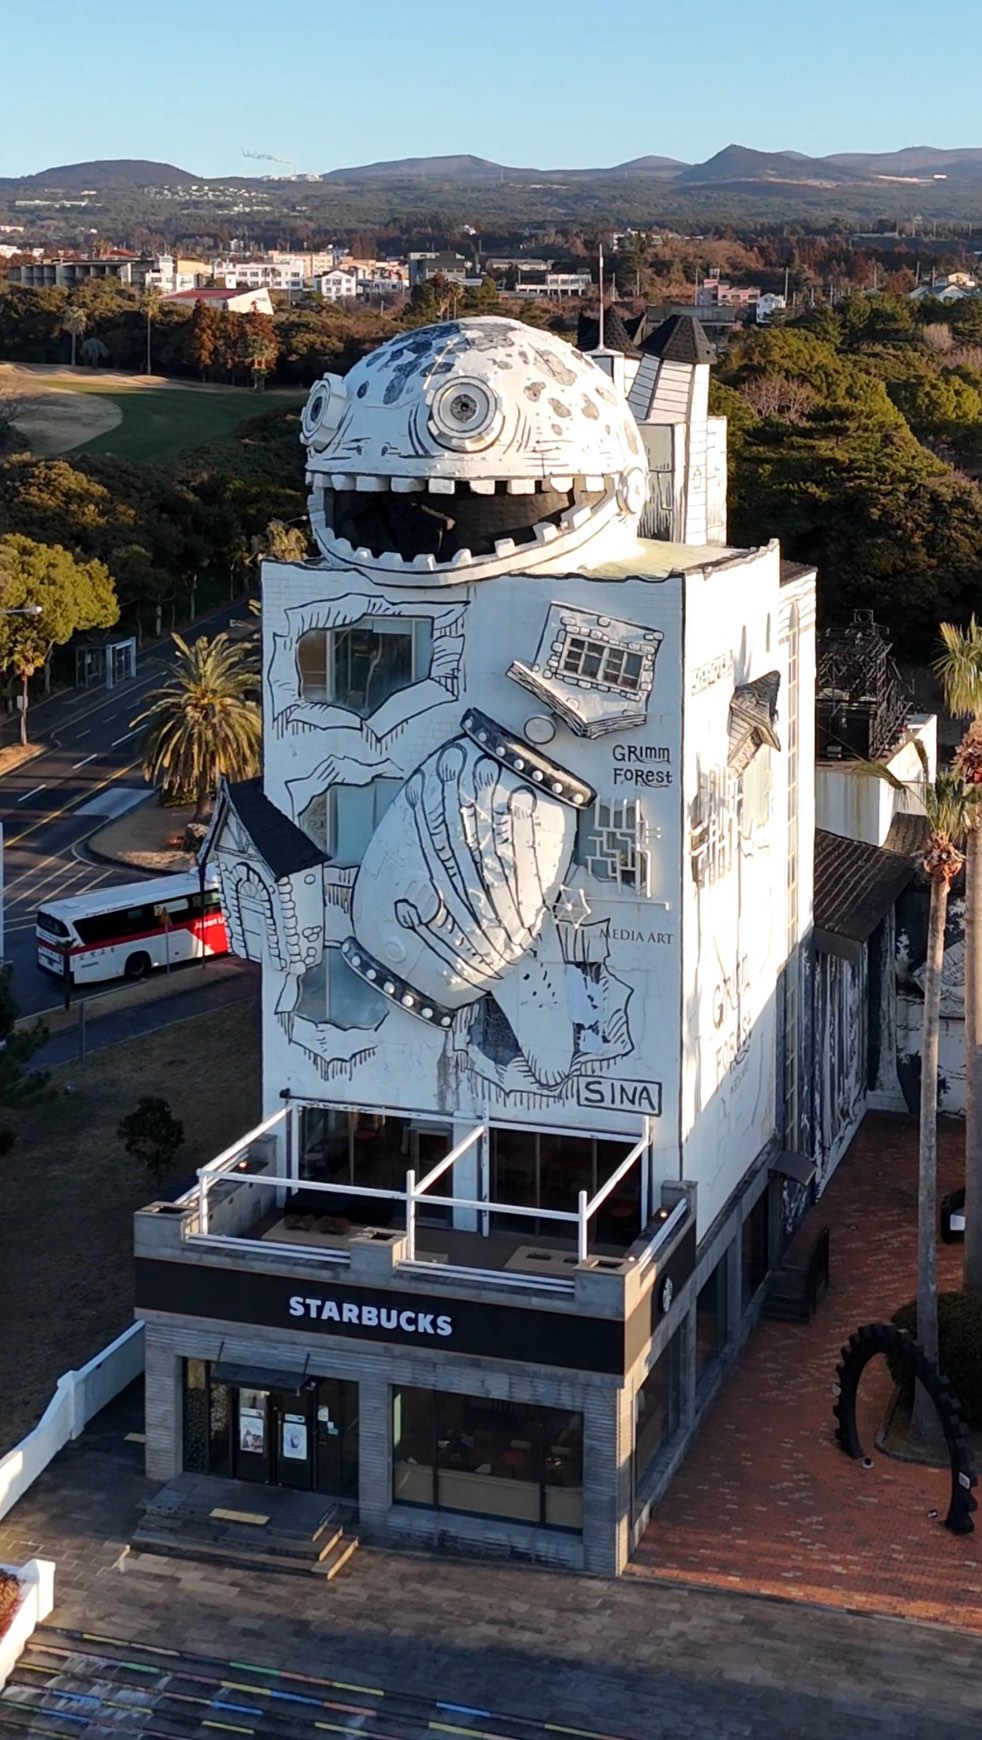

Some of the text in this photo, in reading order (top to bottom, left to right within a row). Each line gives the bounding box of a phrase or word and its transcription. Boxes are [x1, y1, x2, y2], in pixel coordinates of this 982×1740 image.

[600, 928, 674, 944] MEDIA ART
[584, 1080, 656, 1111] SINA
[289, 1296, 453, 1336] STARBUCKS
